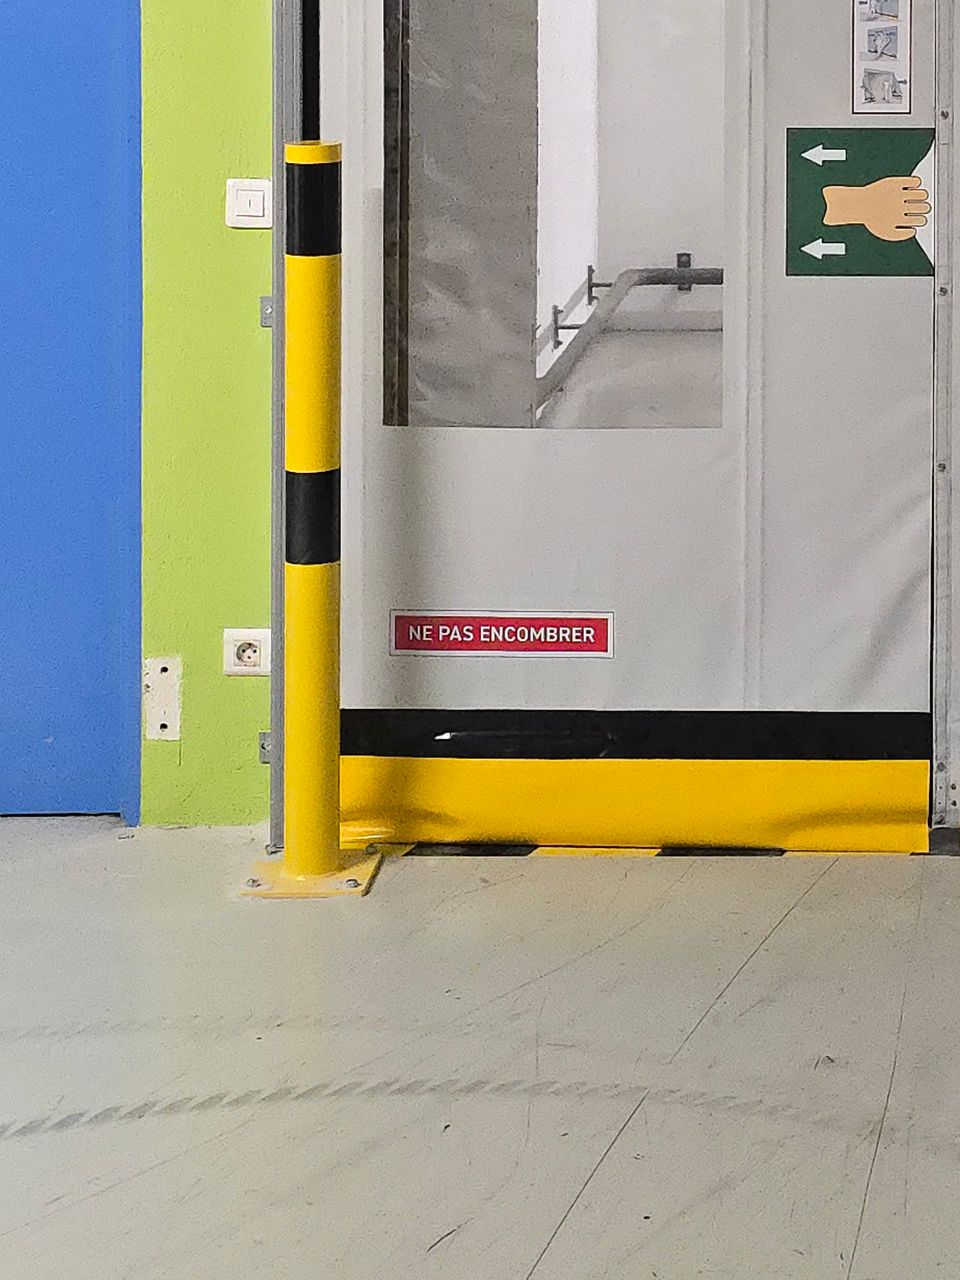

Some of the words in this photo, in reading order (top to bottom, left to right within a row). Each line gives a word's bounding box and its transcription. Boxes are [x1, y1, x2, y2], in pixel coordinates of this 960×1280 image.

[408, 625, 433, 641] NE
[438, 626, 473, 642] PAS
[480, 626, 595, 643] ENCOMBRER
